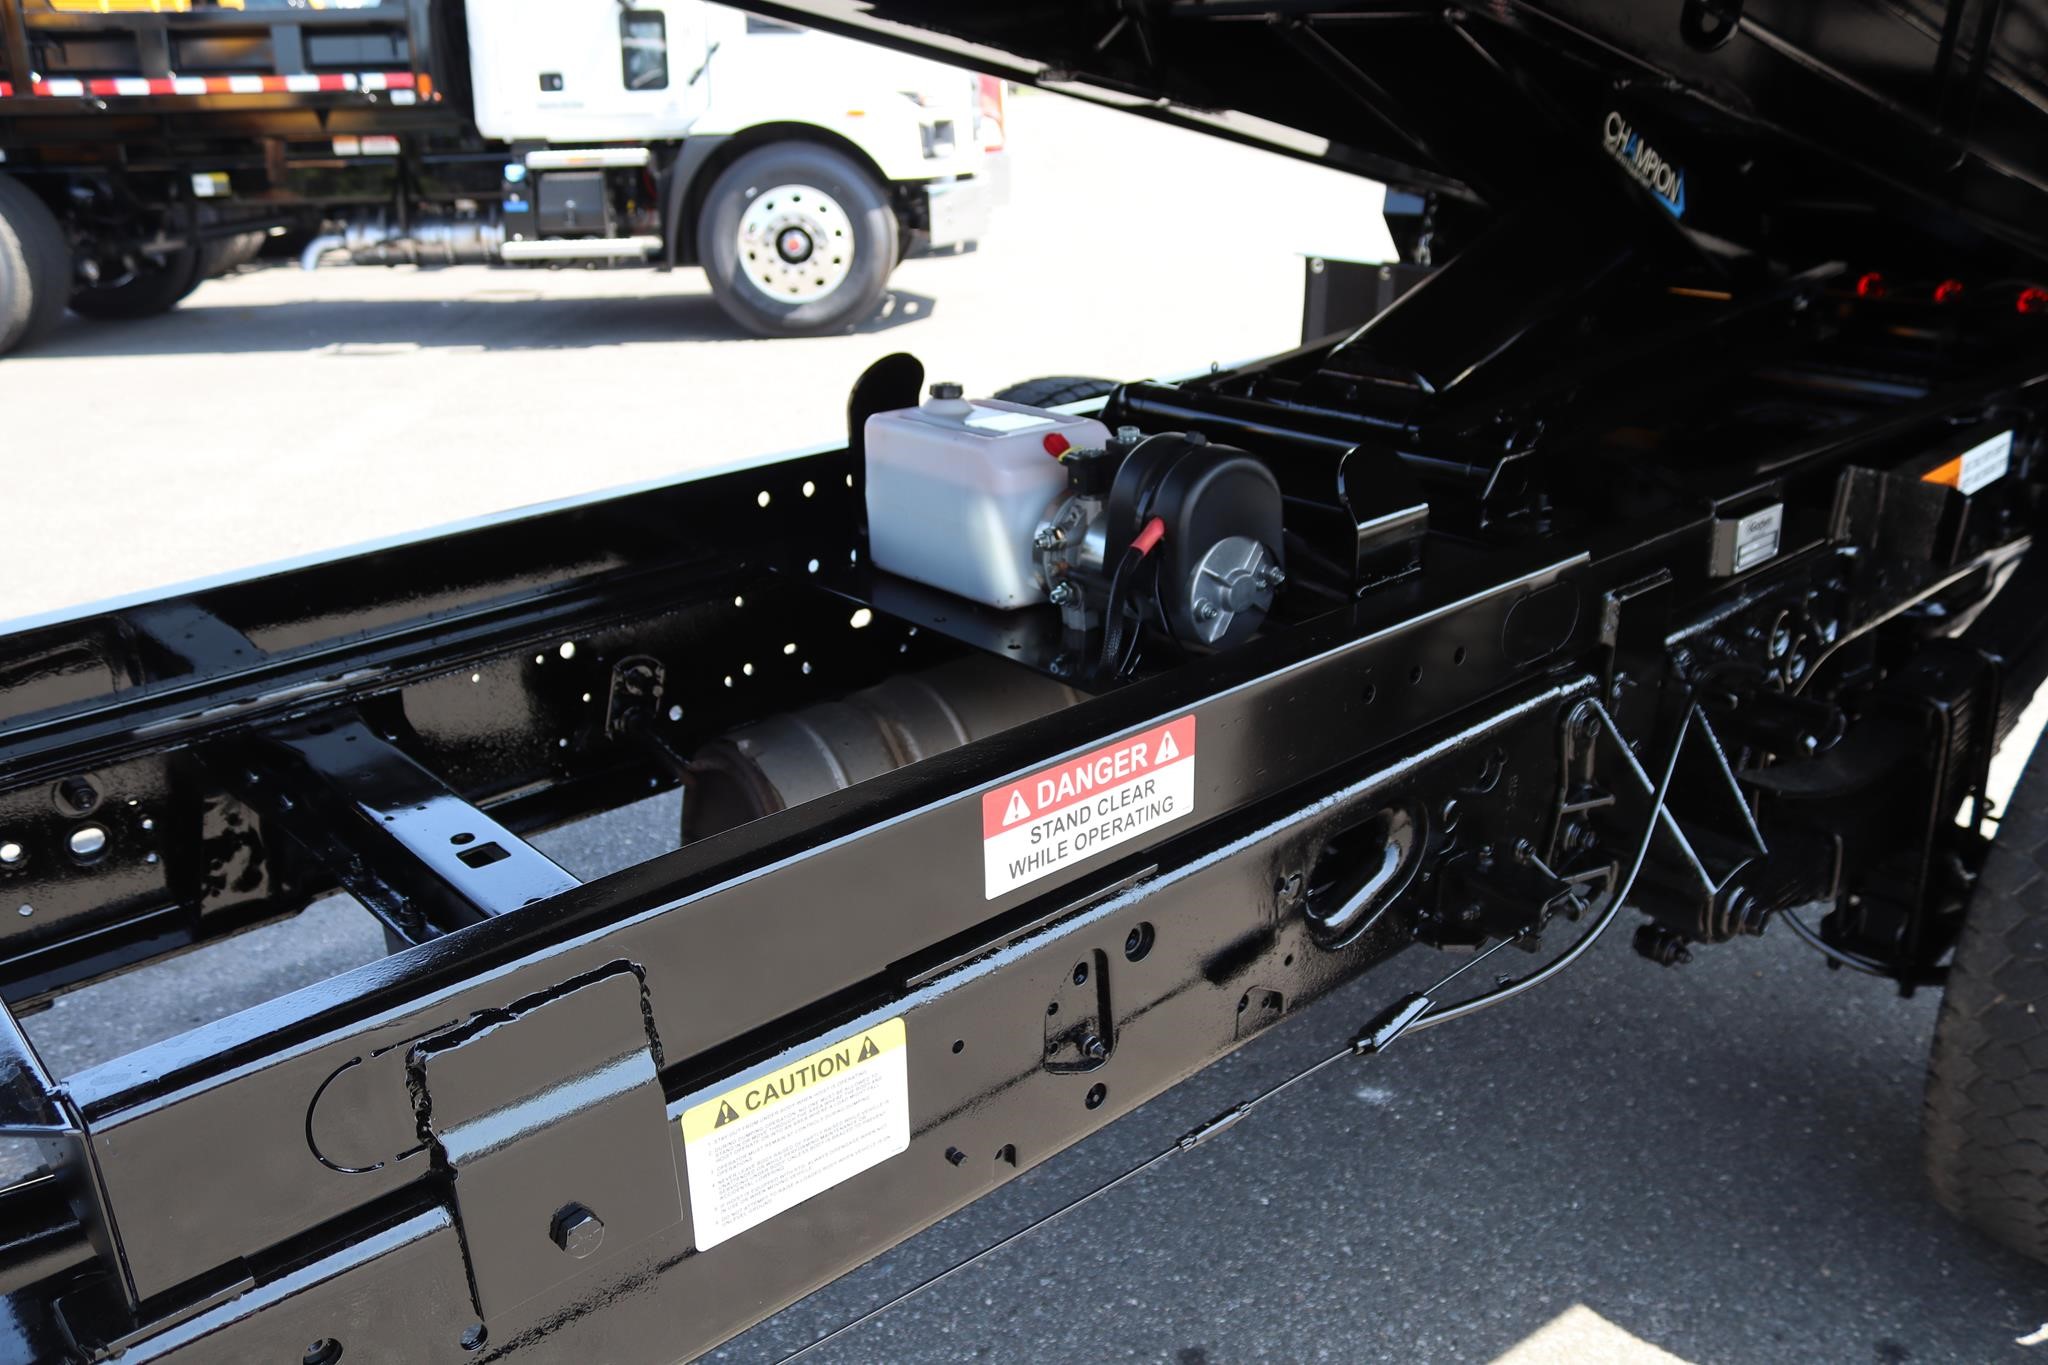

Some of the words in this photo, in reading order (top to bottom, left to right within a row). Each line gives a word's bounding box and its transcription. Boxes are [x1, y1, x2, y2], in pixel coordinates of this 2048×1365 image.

[1603, 111, 1682, 203] CHAMPION
[1037, 743, 1148, 810] DANGER
[1008, 840, 1068, 880] WHILE
[1074, 795, 1174, 851] OPERATING
[1030, 806, 1091, 845] STAND
[1097, 779, 1156, 816] CLEAR
[744, 1049, 851, 1112] CAUTION
